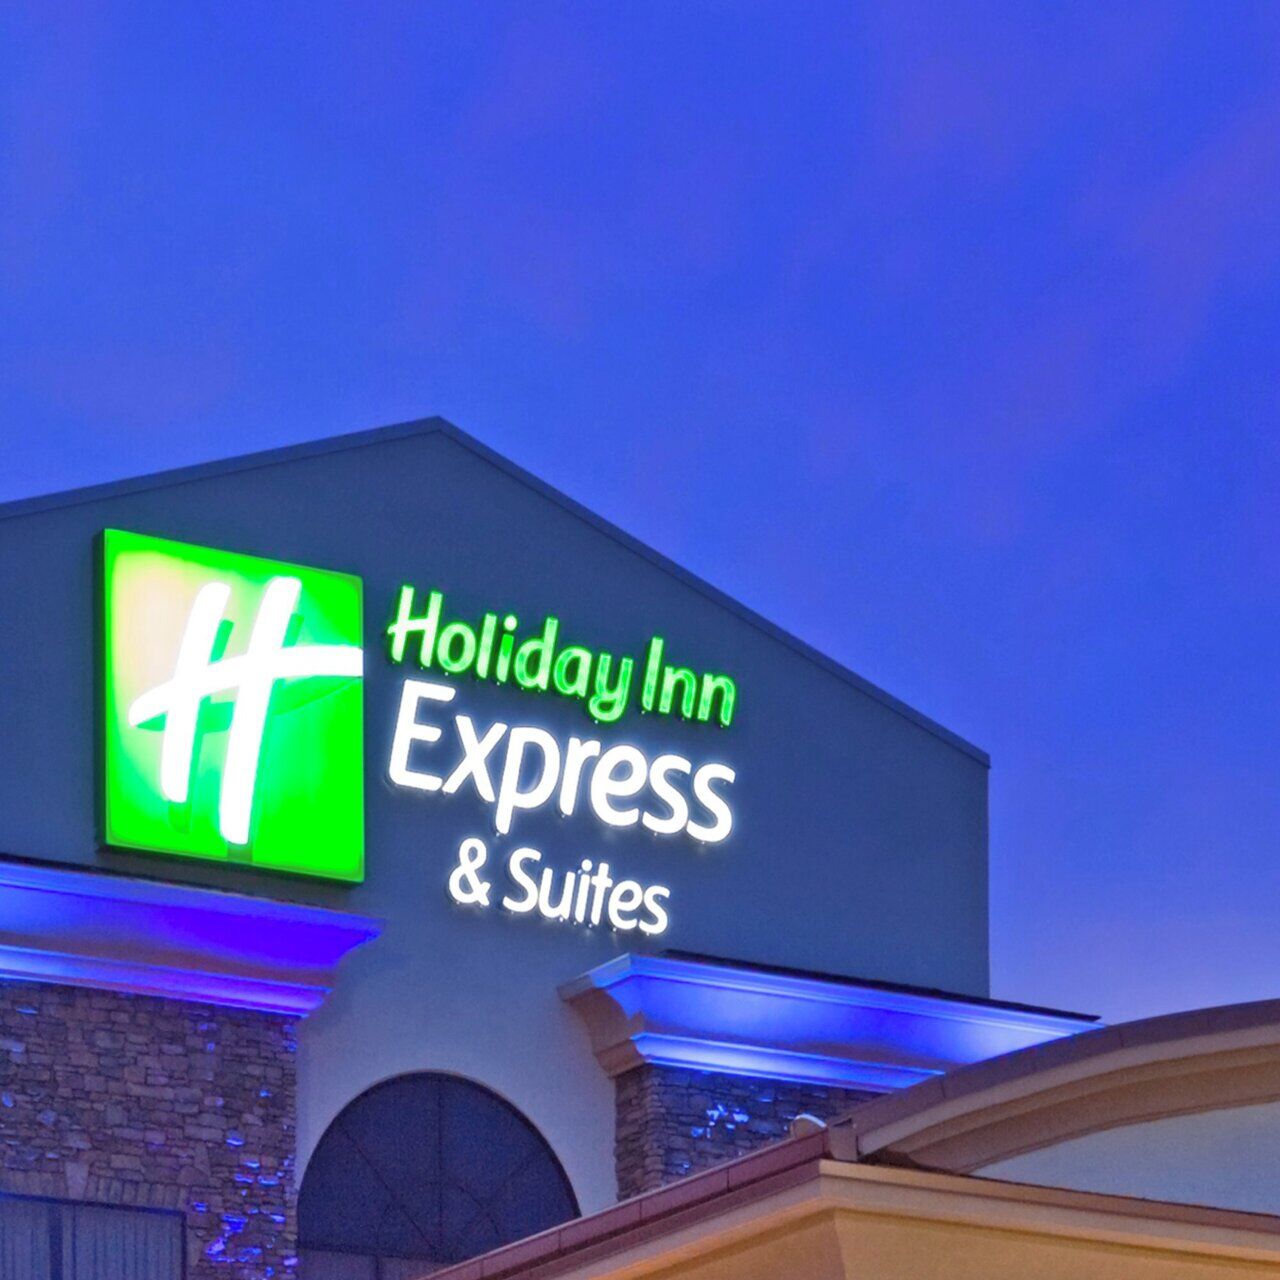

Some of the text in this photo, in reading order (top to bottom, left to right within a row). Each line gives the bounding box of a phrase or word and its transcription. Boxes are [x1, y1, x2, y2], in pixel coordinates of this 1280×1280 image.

[387, 584, 737, 727] Holiday Inn
[387, 678, 737, 844] Express
[447, 837, 671, 936] & Suites
